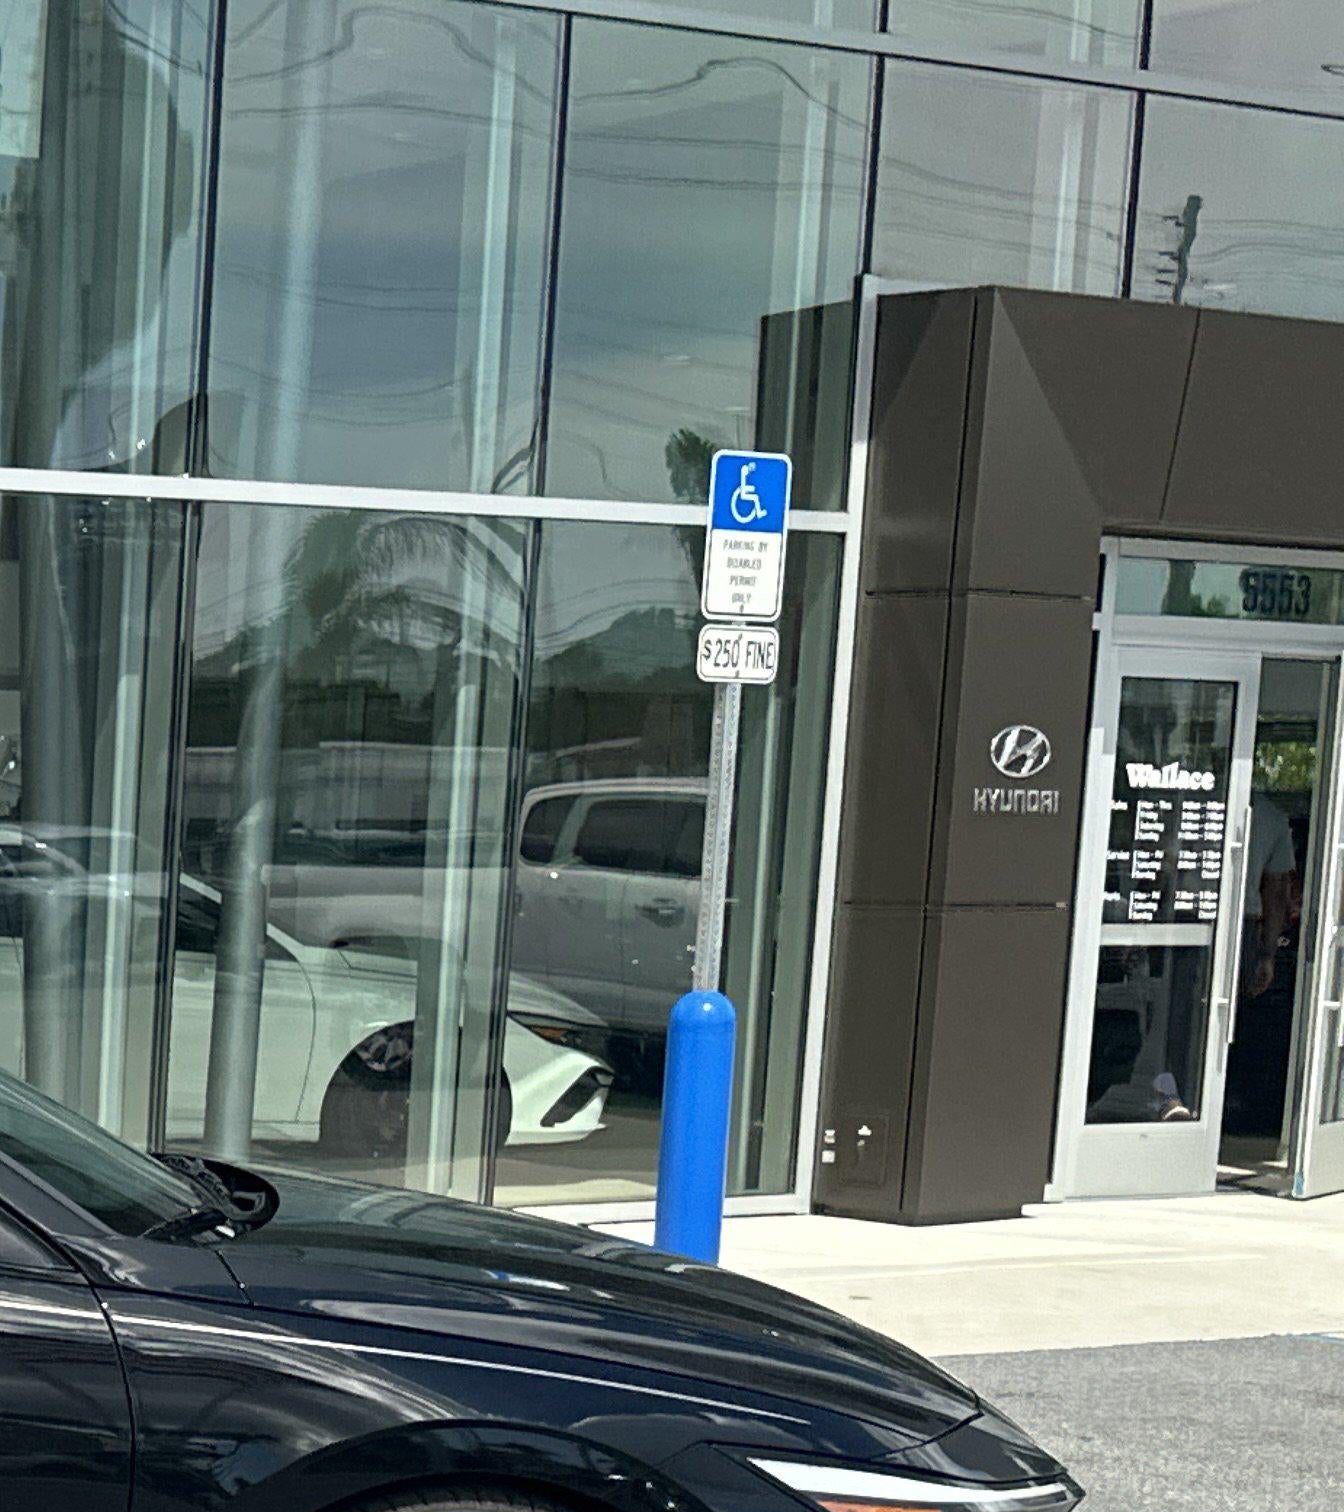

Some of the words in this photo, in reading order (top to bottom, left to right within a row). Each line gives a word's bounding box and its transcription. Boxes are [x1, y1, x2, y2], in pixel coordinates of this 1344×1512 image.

[703, 638, 740, 668] $250
[745, 640, 774, 670] FINE
[1126, 762, 1215, 790] Wallace
[973, 788, 1060, 814] HYUNDAI
